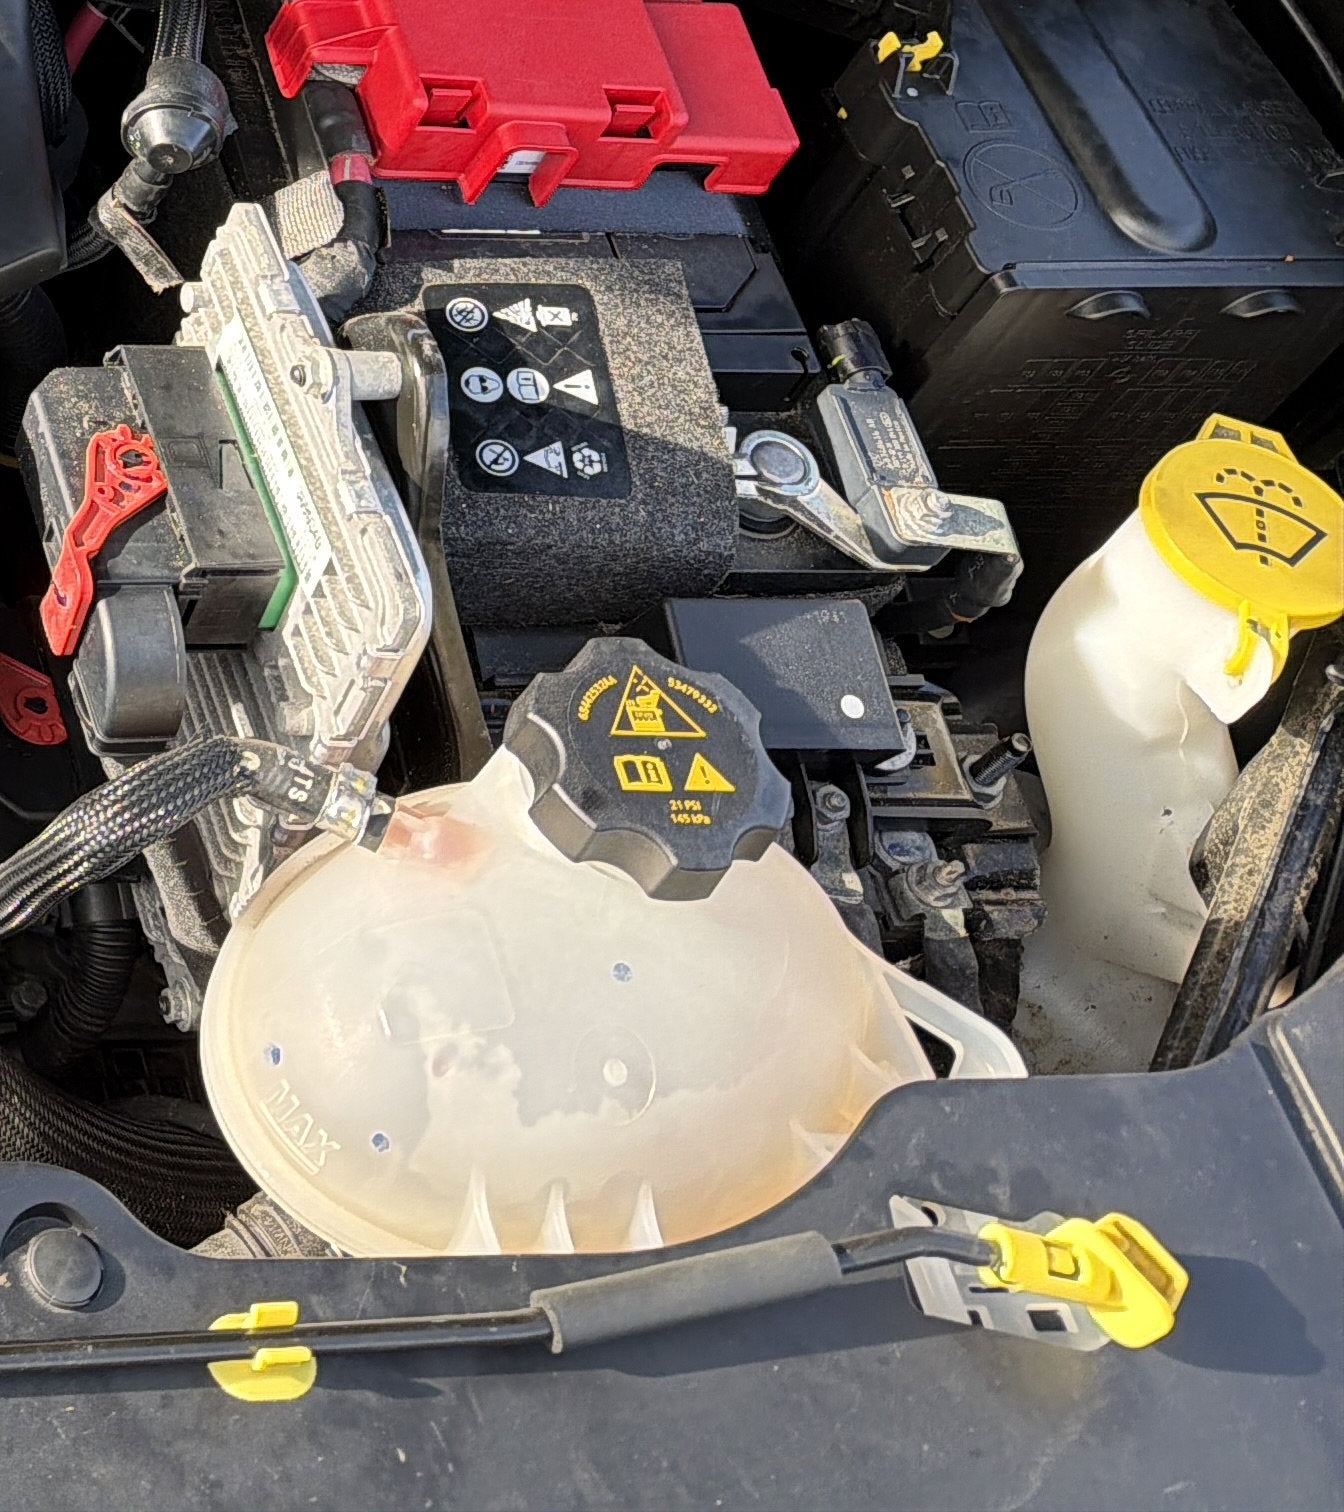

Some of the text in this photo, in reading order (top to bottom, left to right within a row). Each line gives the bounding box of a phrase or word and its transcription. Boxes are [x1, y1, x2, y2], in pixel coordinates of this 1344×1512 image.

[669, 799, 702, 811] 21 PSI
[269, 1077, 342, 1169] MAX
